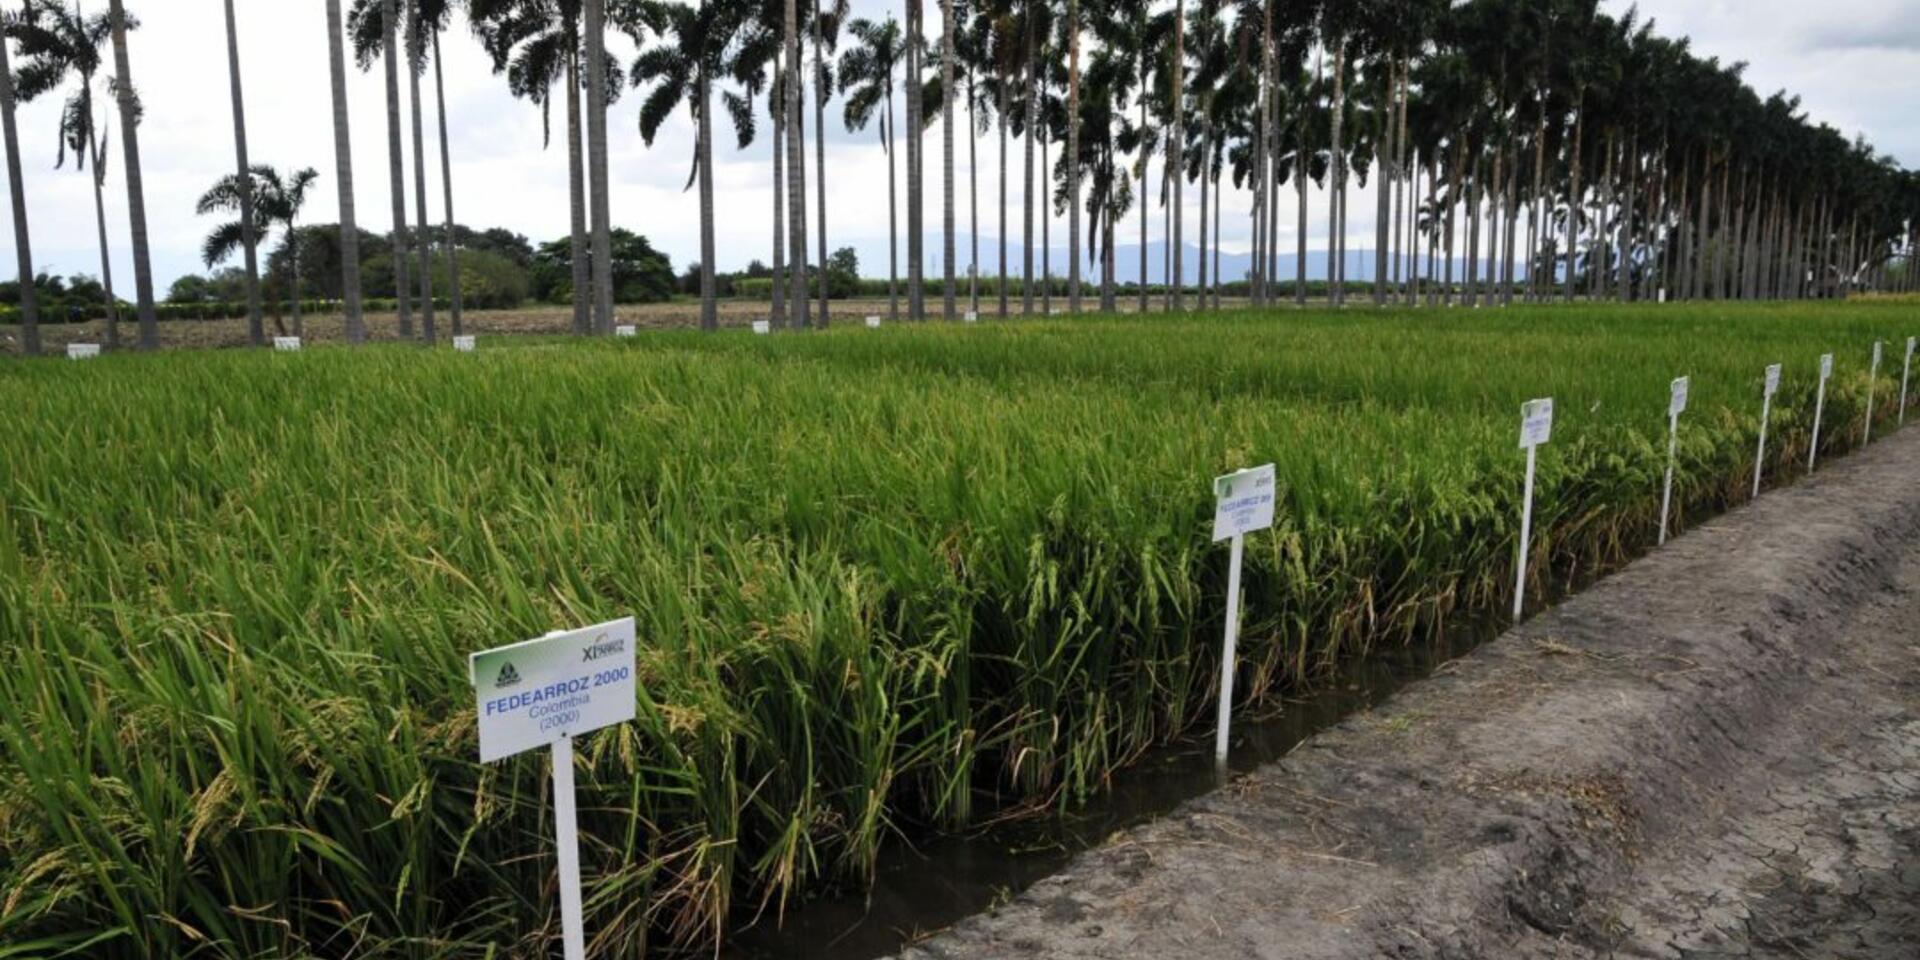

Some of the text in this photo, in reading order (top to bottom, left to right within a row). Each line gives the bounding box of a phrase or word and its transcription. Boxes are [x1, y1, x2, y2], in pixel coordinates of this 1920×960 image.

[485, 666, 629, 717] FEDEARROZ 2000
[528, 694, 591, 720] Colombia
[539, 710, 581, 734] (2000)
